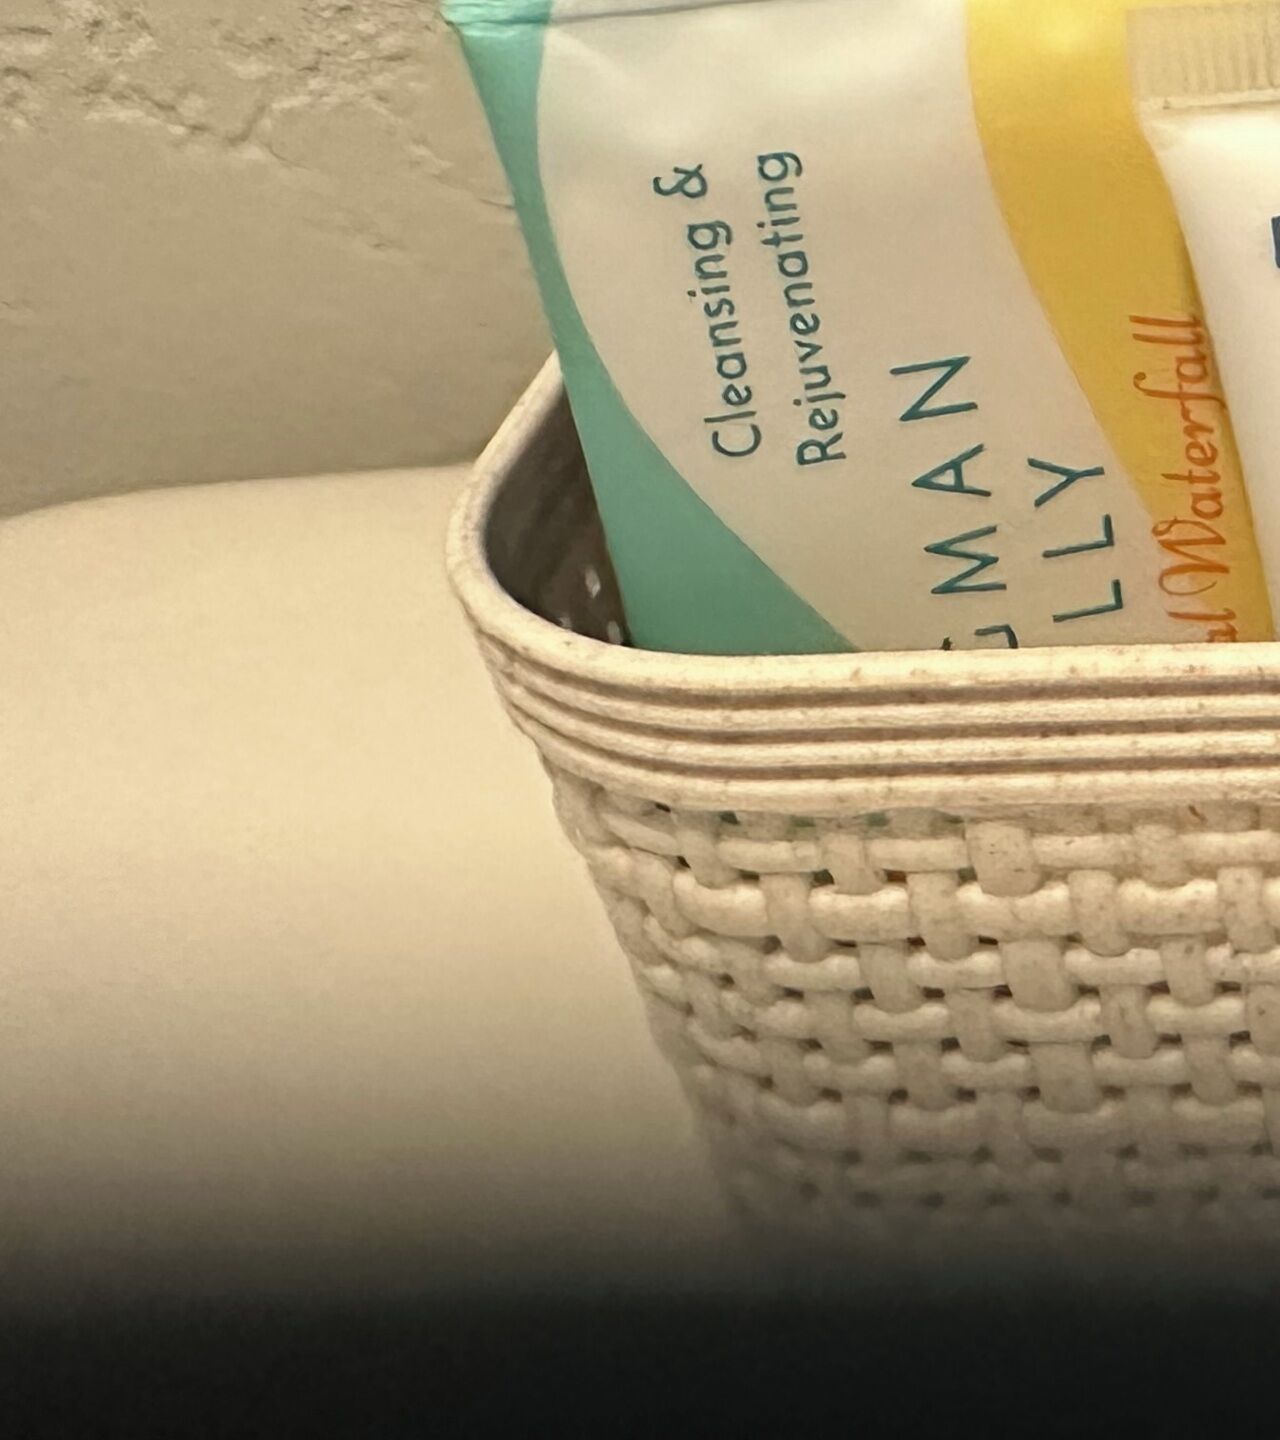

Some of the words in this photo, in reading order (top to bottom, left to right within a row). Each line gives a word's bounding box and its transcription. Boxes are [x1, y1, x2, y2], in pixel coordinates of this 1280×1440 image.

[652, 163, 709, 199] &
[756, 150, 847, 466] Rejuvenating
[685, 219, 762, 458] Cleansing
[1128, 314, 1231, 596] Waterfall
